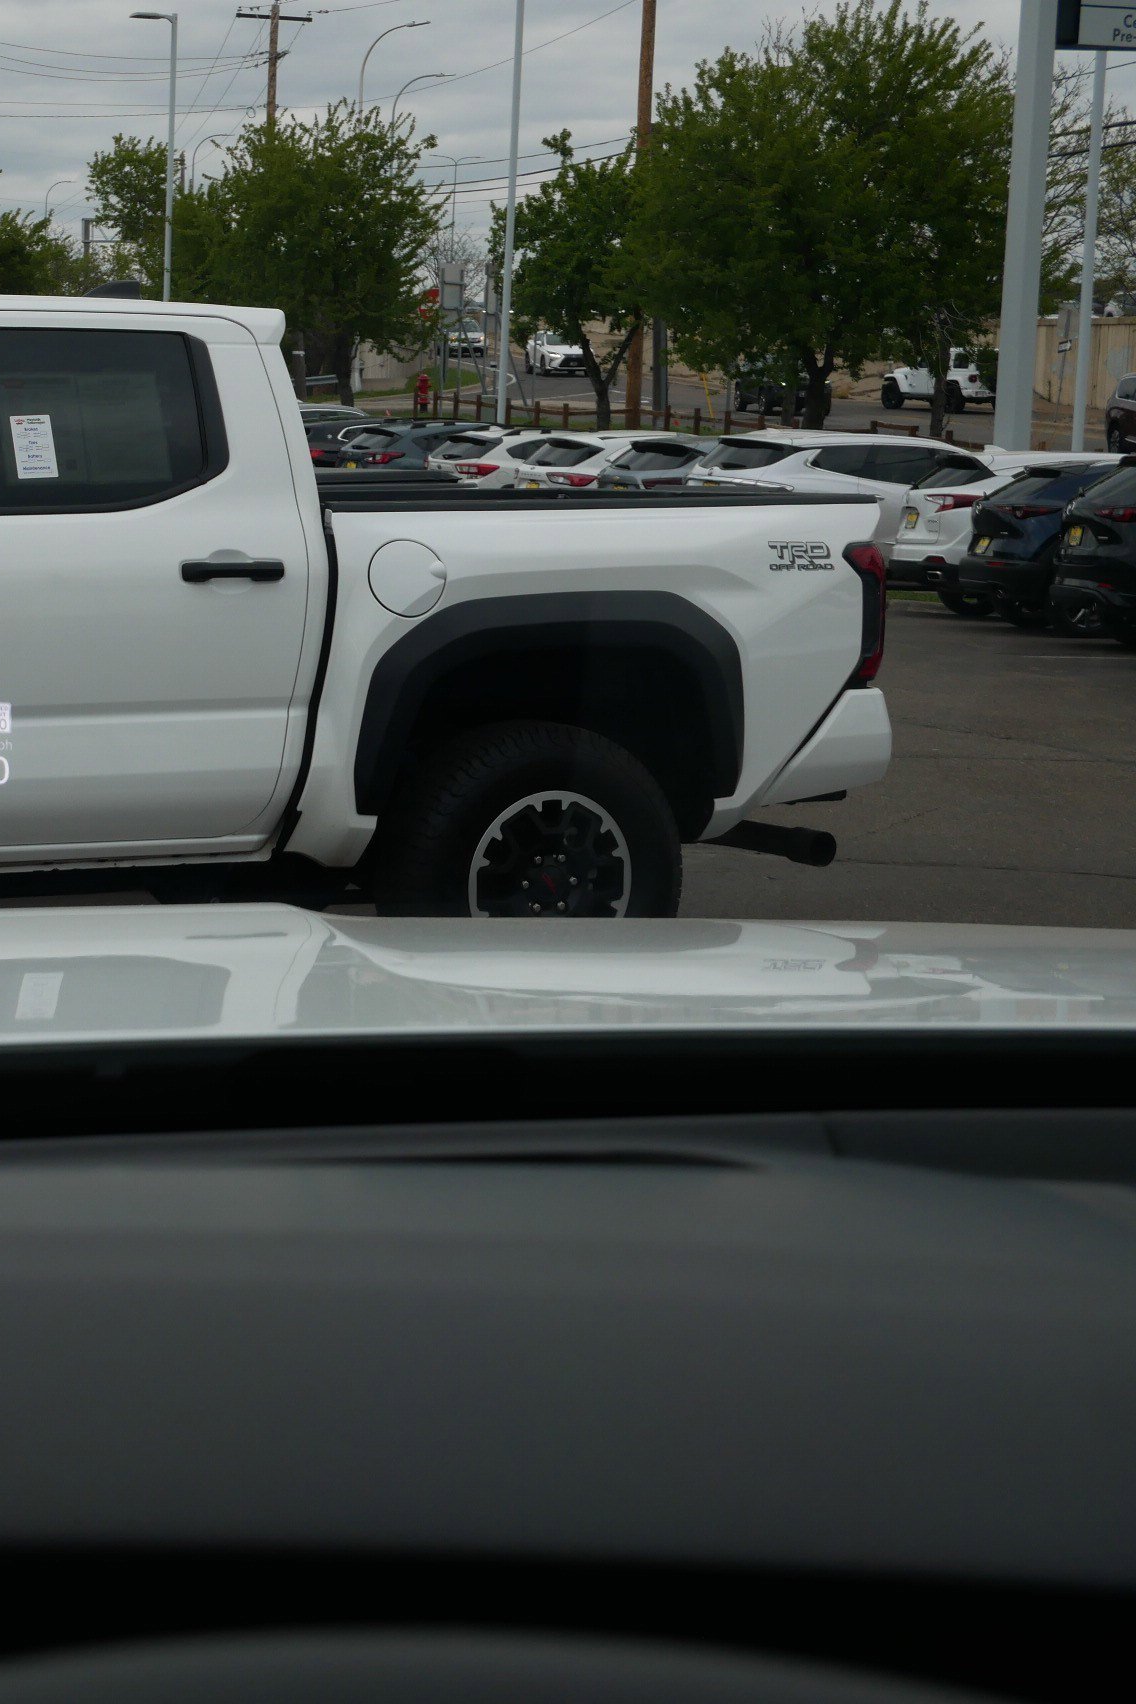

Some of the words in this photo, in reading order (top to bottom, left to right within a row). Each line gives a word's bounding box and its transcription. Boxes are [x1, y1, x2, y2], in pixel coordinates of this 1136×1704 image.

[768, 541, 831, 564] TRD
[769, 563, 796, 571] OFF
[797, 563, 835, 571] ROAD
